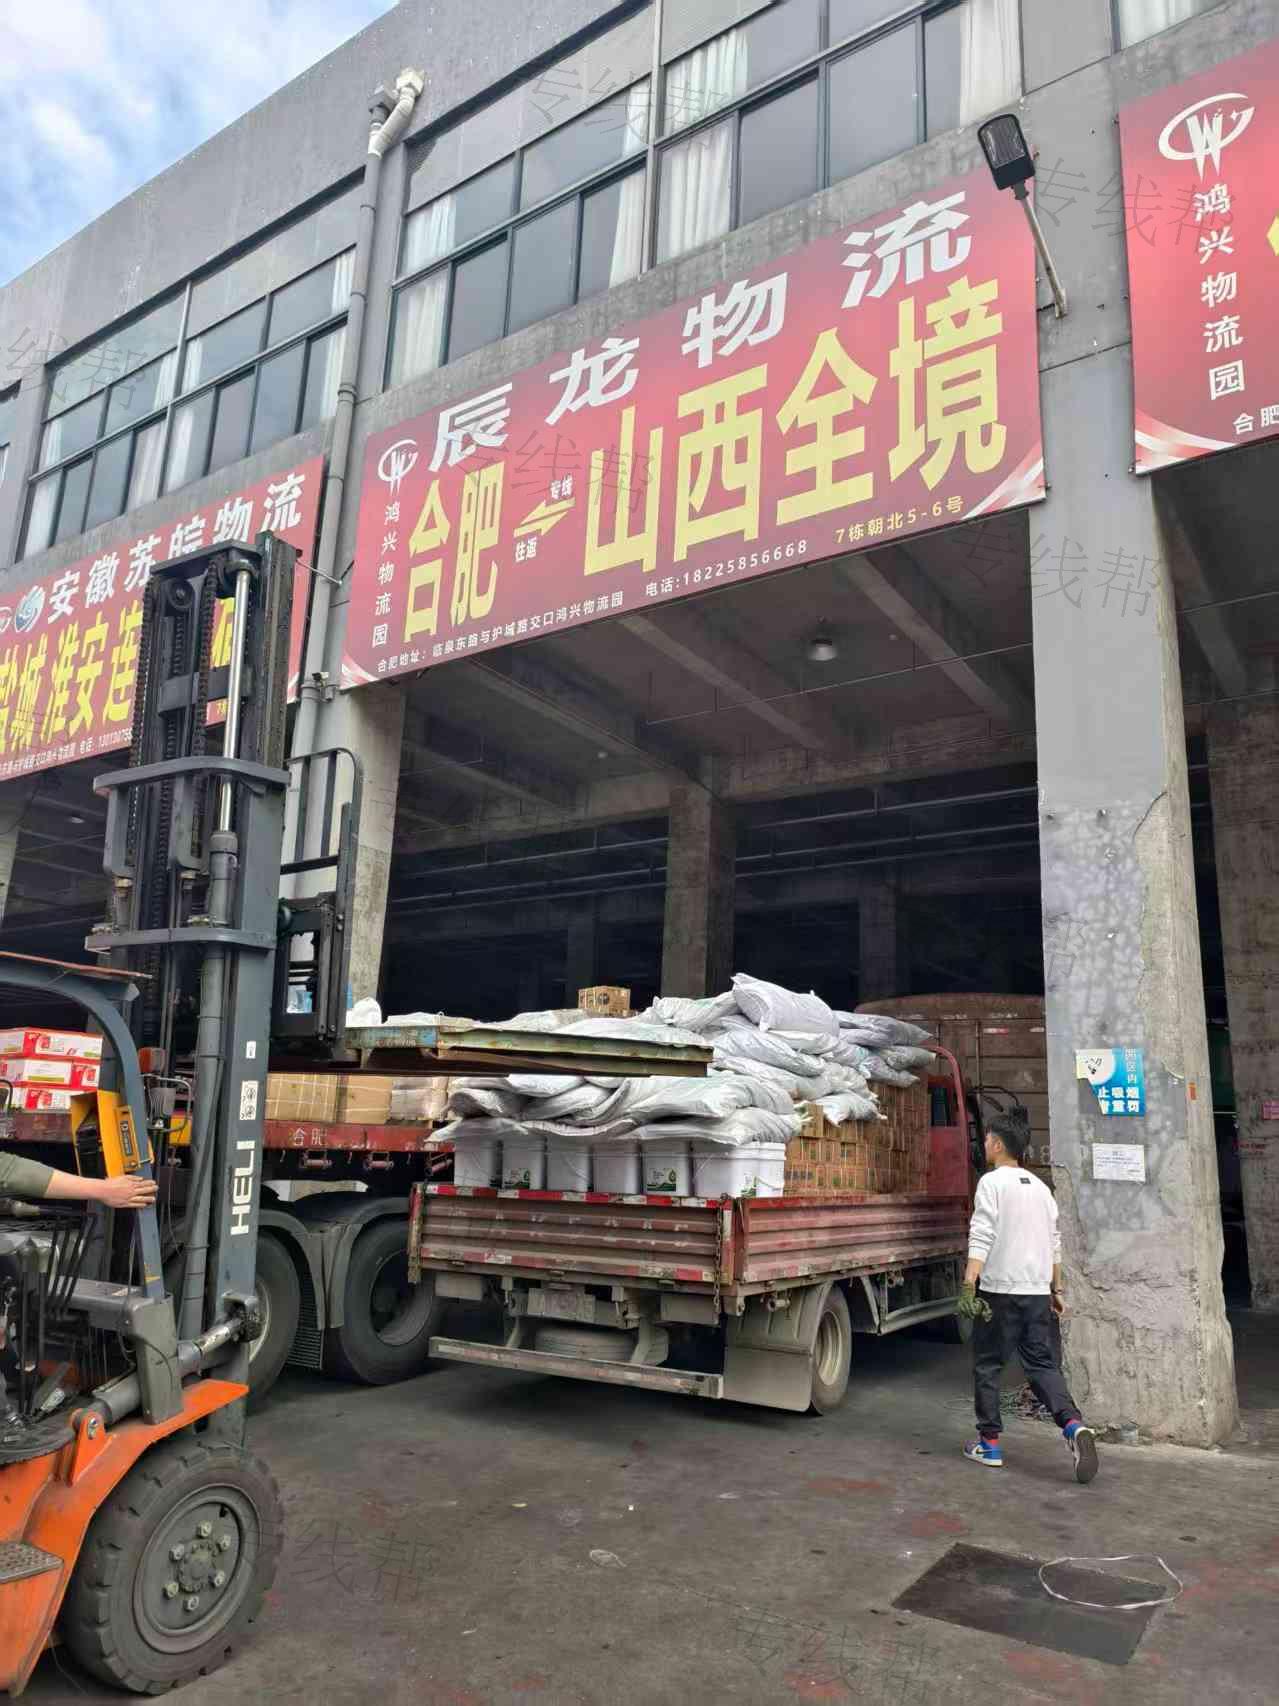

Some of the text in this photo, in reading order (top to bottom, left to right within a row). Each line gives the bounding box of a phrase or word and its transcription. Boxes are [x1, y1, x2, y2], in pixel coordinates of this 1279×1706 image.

[428, 190, 971, 473] 辰龙物流
[1191, 182, 1246, 401] 鸿兴物流园
[583, 276, 1007, 577] 山西全境
[371, 500, 401, 649] 鸿兴物流园
[403, 461, 505, 644] 合肥
[834, 495, 965, 545] 7栋朝北5-6号
[230, 1140, 256, 1236] HELI
